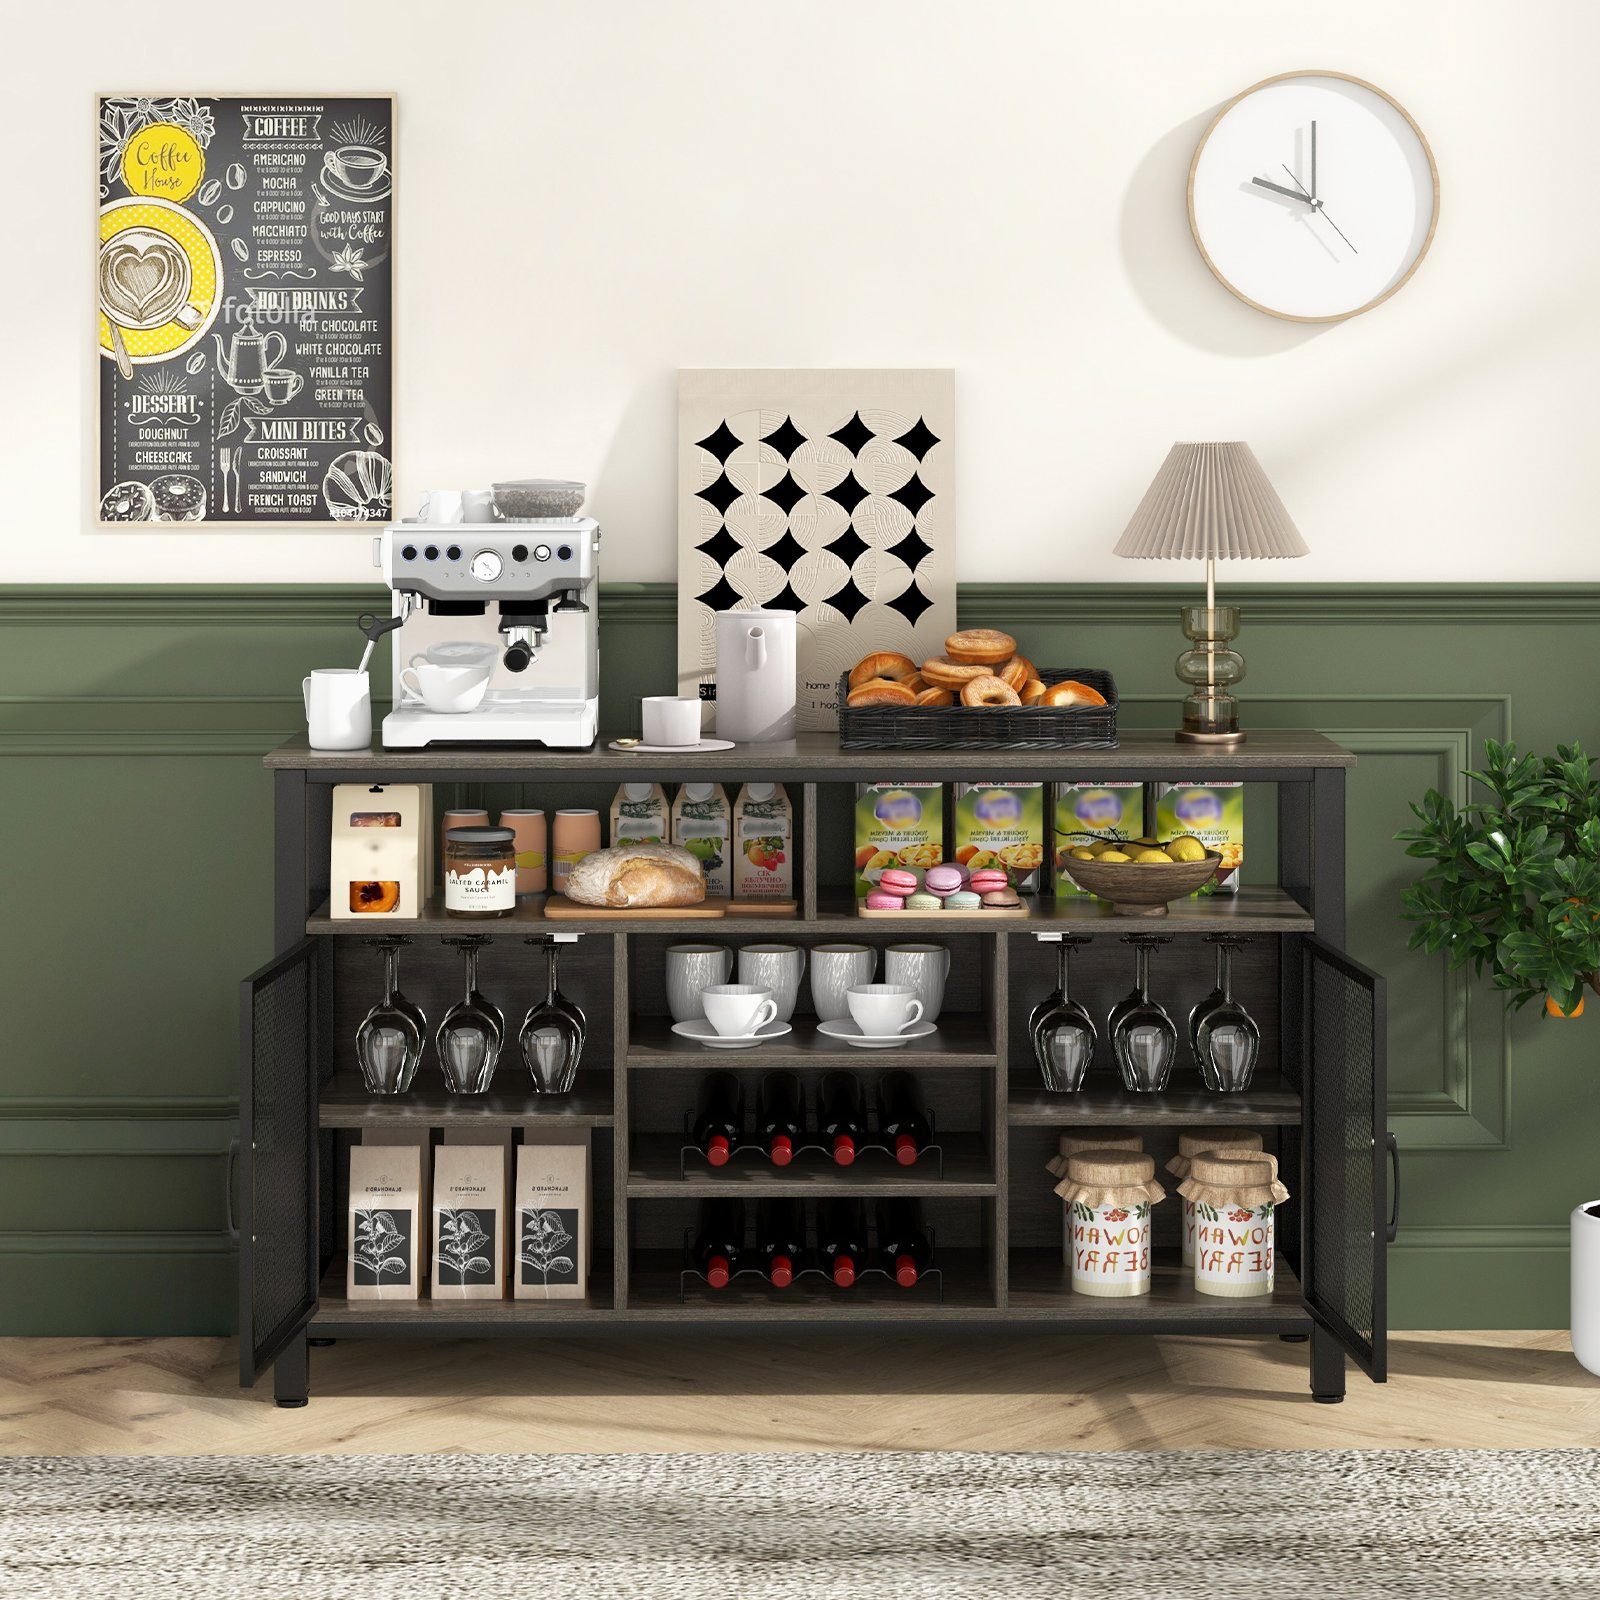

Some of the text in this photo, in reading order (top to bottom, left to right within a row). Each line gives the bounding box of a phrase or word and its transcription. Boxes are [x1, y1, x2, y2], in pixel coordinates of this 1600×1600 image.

[254, 117, 307, 136] COFFEE
[137, 141, 192, 171] Coffee
[253, 153, 306, 166] AMERICANO
[143, 167, 183, 191] House
[262, 177, 297, 189] MOCHA
[253, 201, 306, 213] CAPPUCINO
[320, 211, 385, 224] GOOD DAYS START
[252, 225, 307, 237] MACCHIATO
[320, 223, 385, 243] with Coffee
[257, 249, 302, 262] ESPRESSO
[257, 291, 348, 310] HOT DRINKS
[299, 320, 378, 332] HOT CHOCOLATE
[295, 343, 382, 355] WHITE CHOCOLATE
[309, 366, 369, 378] VANILLA TEA
[314, 389, 364, 401] GREEN TEA
[132, 394, 198, 413] DESSERT
[139, 428, 189, 440] DOUGHNUT
[261, 421, 346, 440] MINI BITES
[135, 451, 193, 463] CHEESECAKE
[257, 447, 308, 459] CROISSANT
[259, 471, 307, 483] SANDWICH
[248, 494, 317, 506] FRENCH TOAST
[806, 681, 830, 690] home
[820, 701, 839, 711] hop
[449, 878, 472, 886] SALTED
